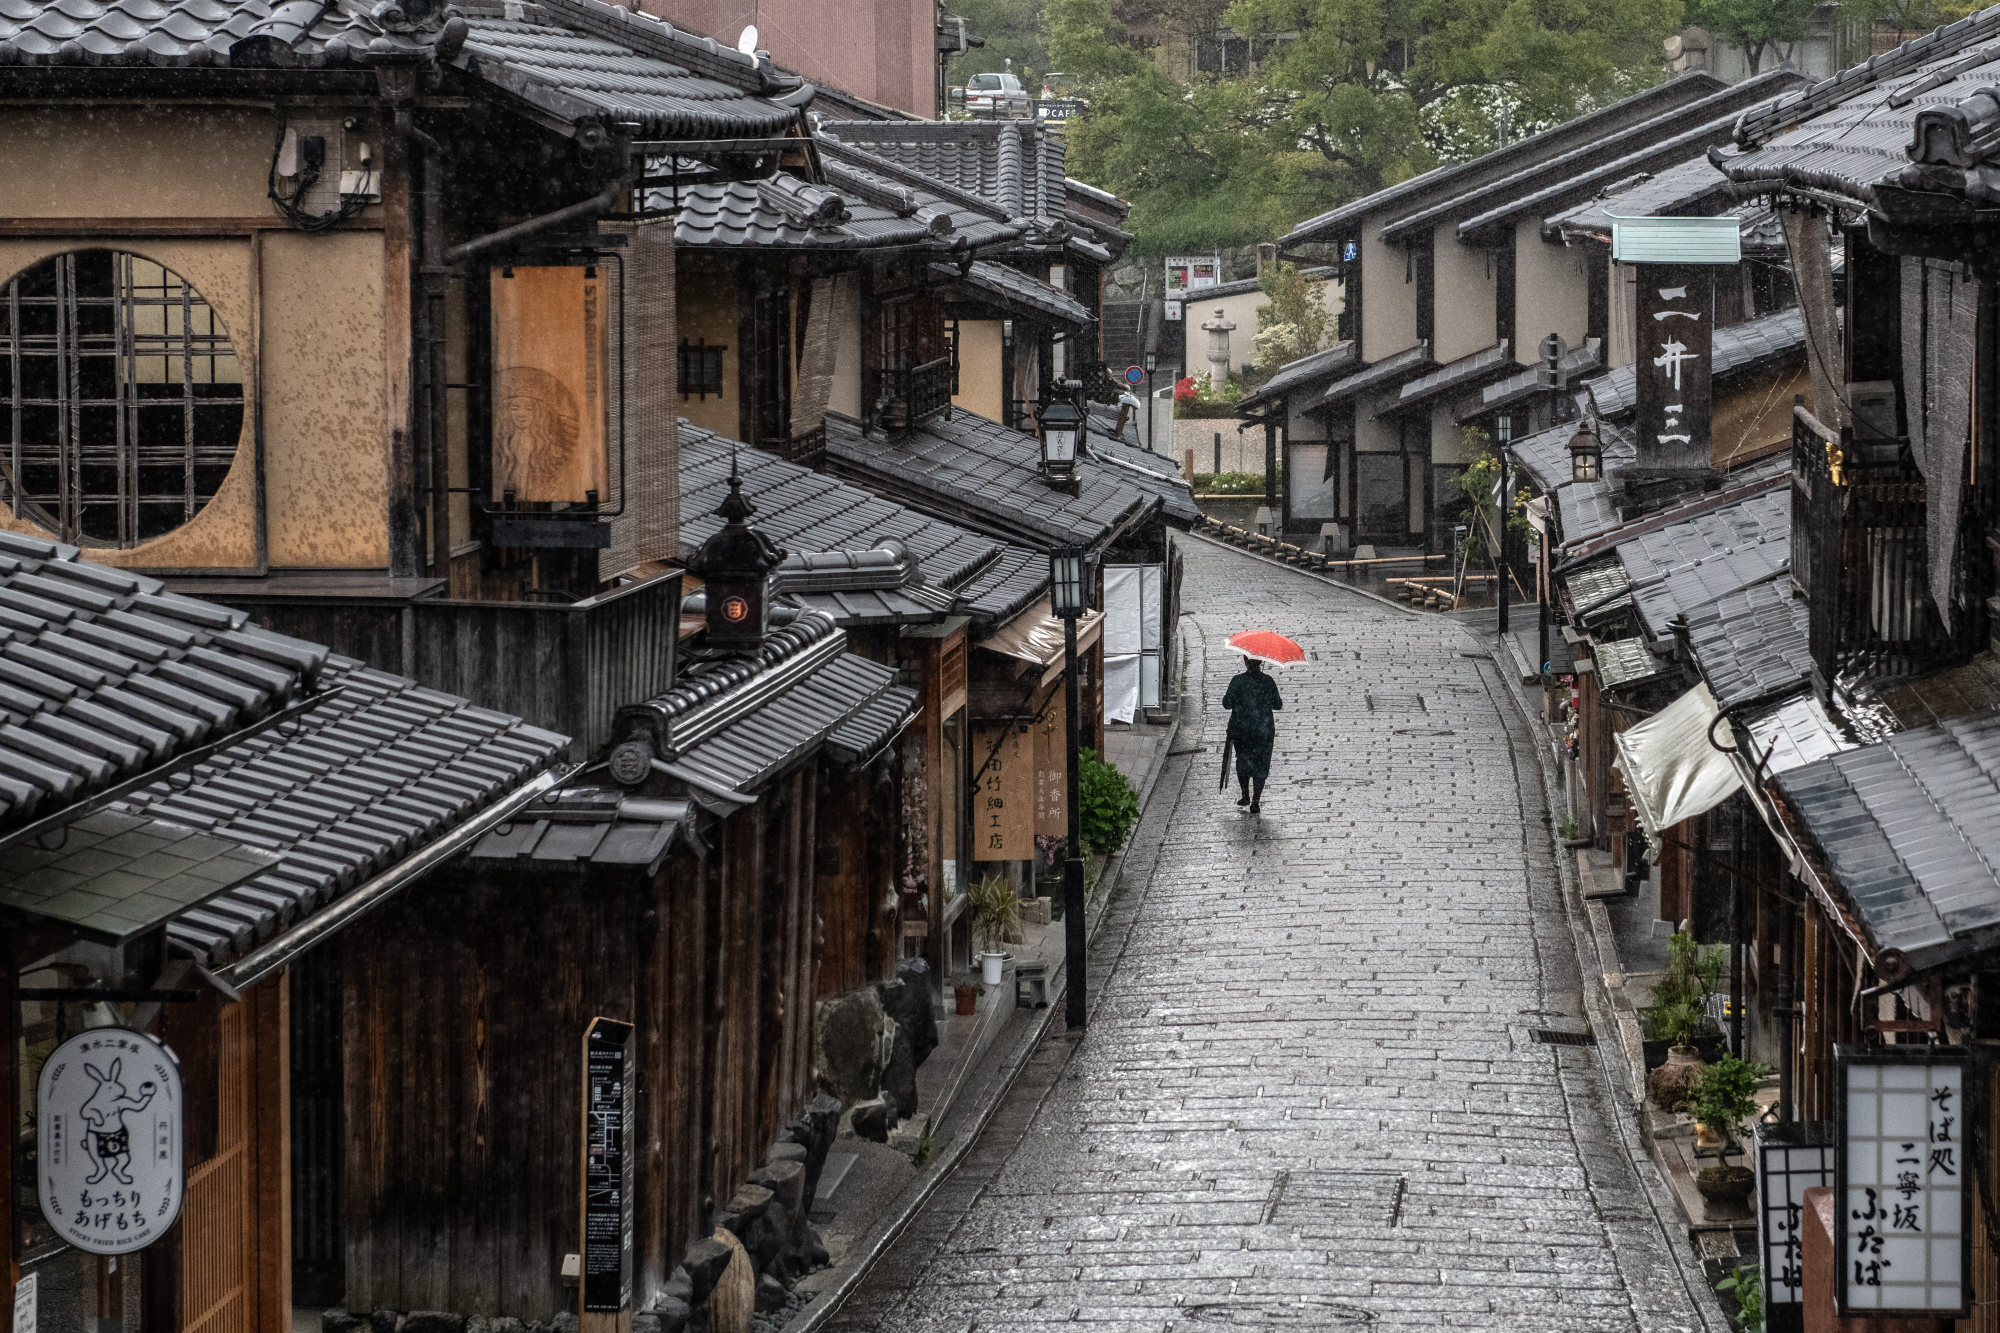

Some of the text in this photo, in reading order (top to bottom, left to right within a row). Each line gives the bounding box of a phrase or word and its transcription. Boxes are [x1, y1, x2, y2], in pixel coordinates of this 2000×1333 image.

[1047, 769, 1062, 821] 御香所
[1927, 1085, 1957, 1176] そば処
[79, 1189, 141, 1208] もっちり
[1892, 1143, 1922, 1232] 二寧坂
[69, 1227, 151, 1246] STICKY FRIED RICE CAKE
[74, 1210, 146, 1230] あげもち
[1852, 1188, 1891, 1287] ふたば
